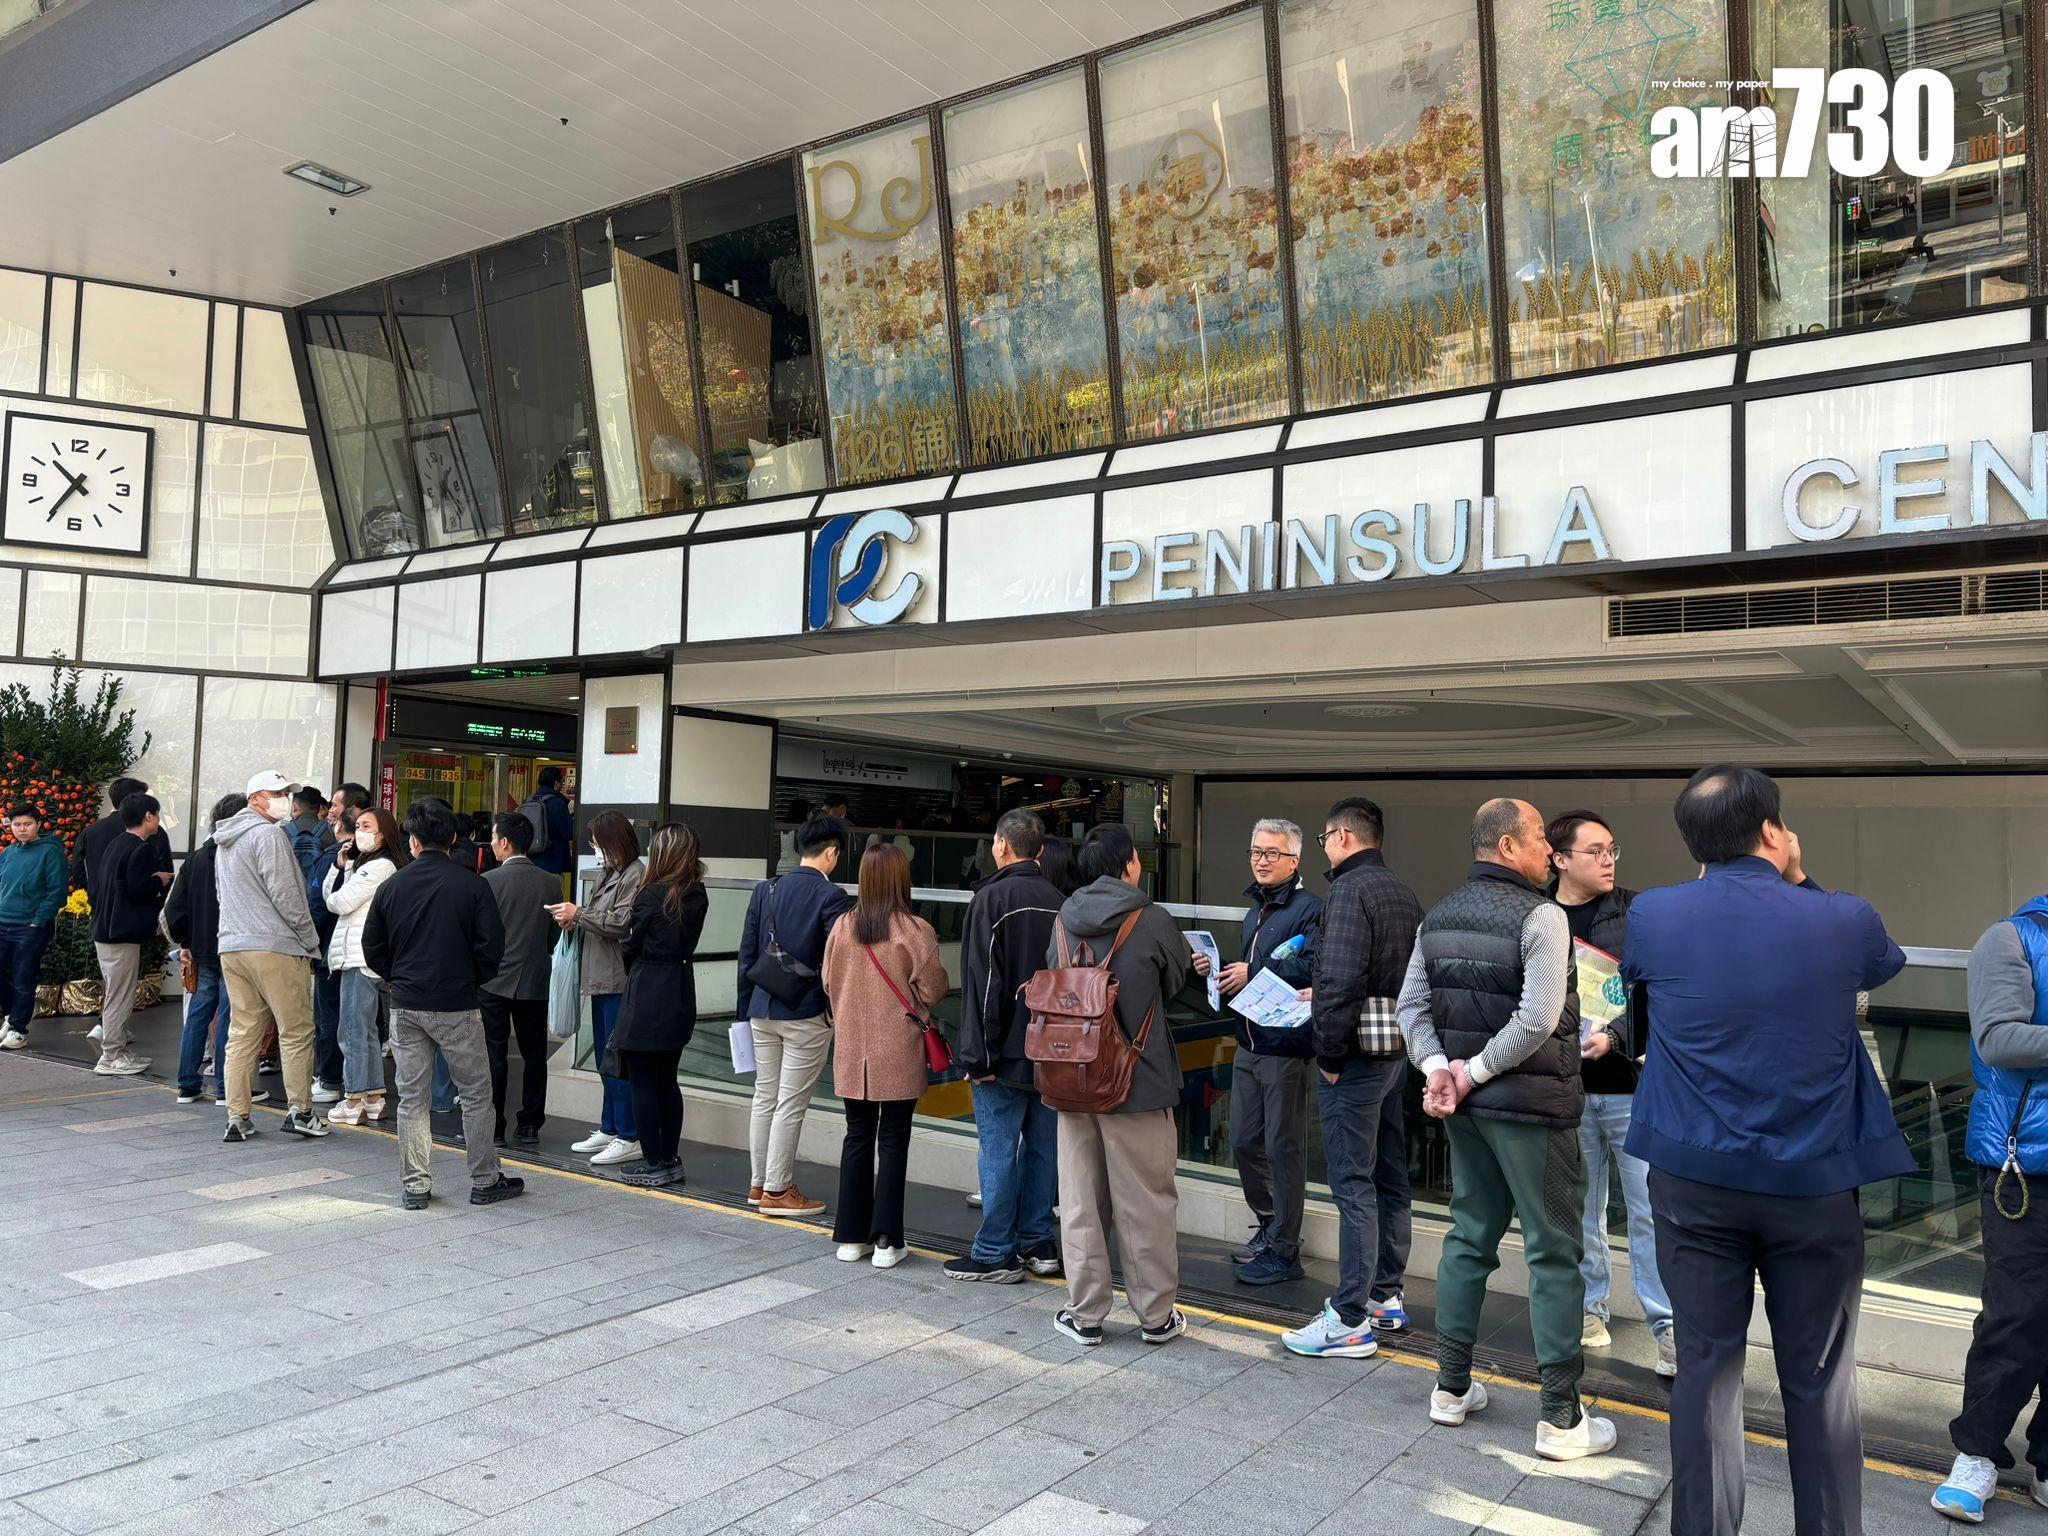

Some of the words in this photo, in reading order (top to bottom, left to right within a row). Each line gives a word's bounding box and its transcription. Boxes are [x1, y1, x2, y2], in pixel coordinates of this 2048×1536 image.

[70, 439, 89, 454] 12
[22, 473, 37, 488] 9
[116, 483, 131, 497] 3
[67, 517, 82, 531] 6
[1100, 485, 1612, 606] PENINSULA
[1782, 432, 2048, 542] CEN
[406, 768, 425, 779] 945
[441, 770, 460, 781] 935
